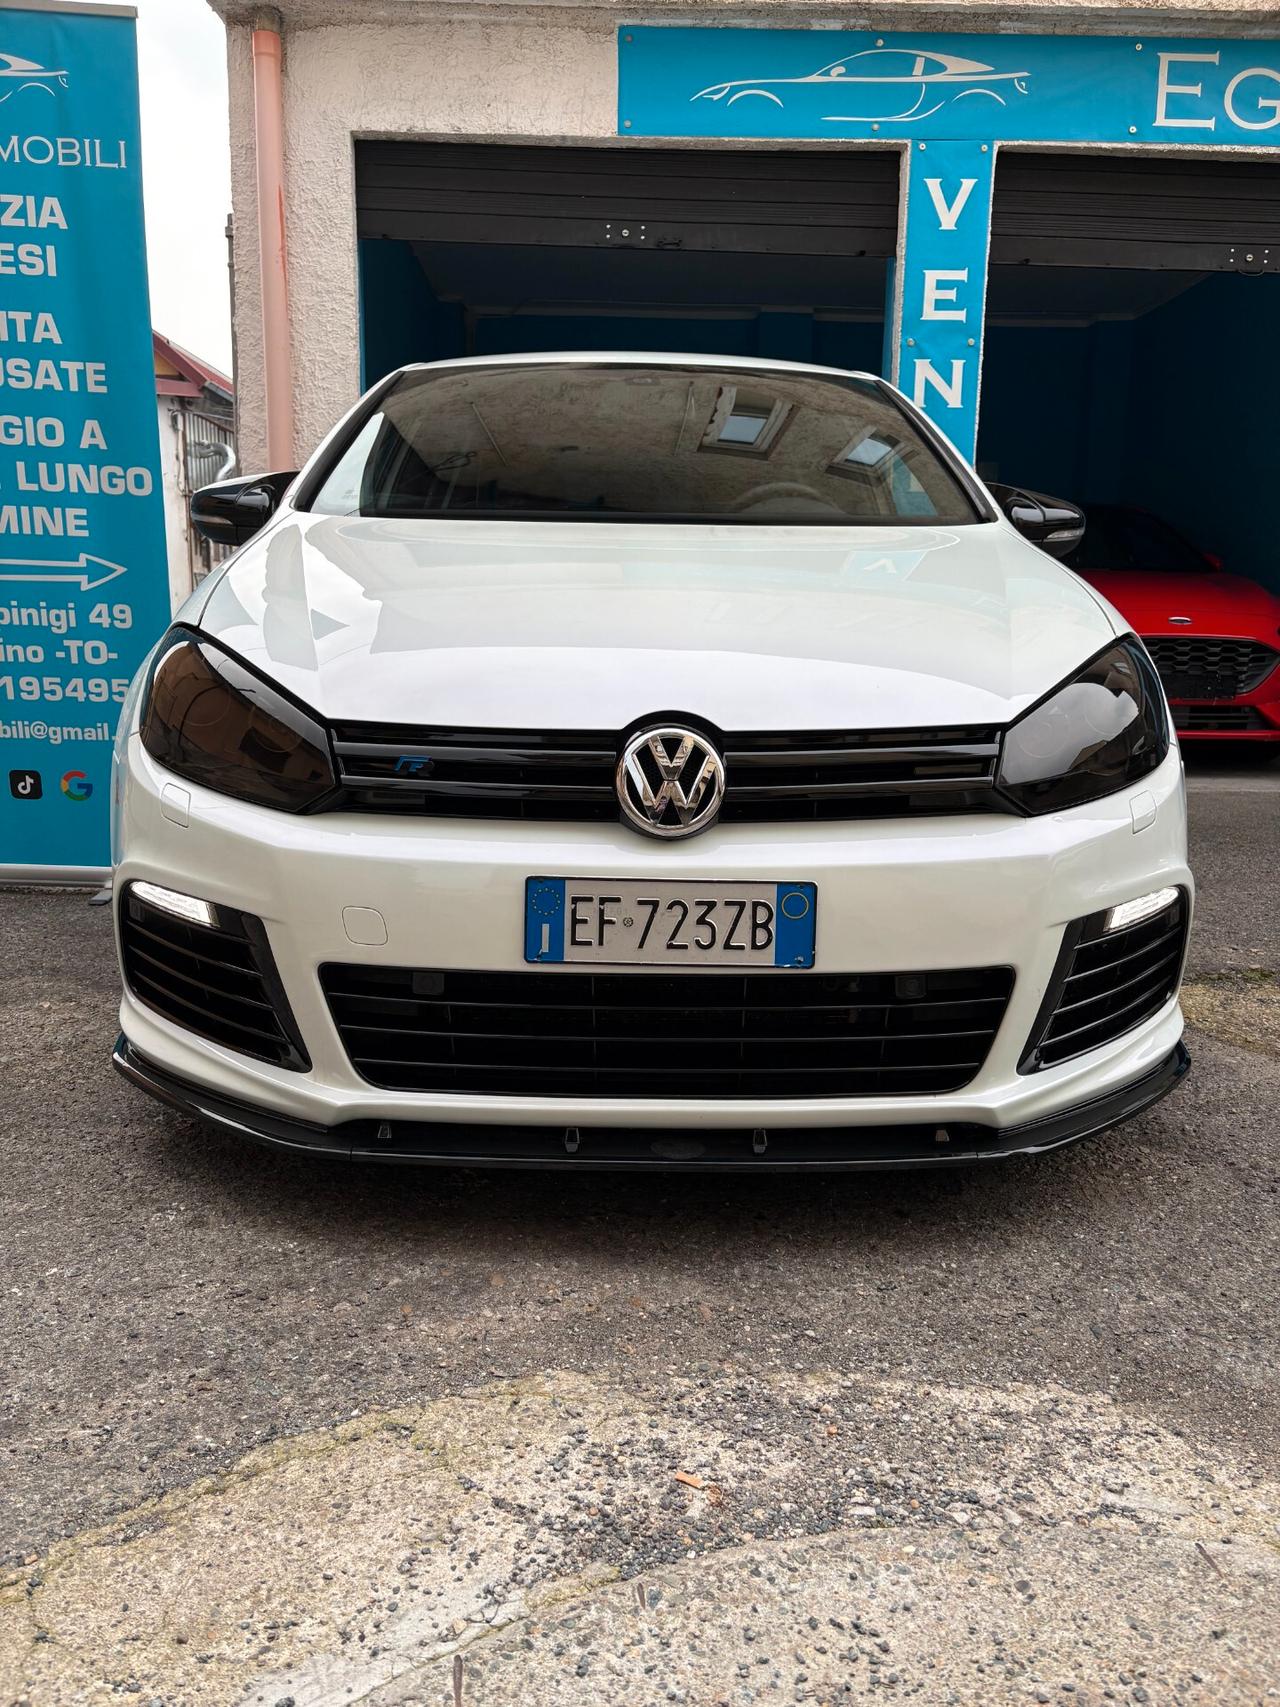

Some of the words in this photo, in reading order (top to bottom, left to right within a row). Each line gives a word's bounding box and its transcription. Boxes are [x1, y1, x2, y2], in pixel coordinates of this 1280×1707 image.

[1152, 51, 1280, 130] EG
[0, 193, 69, 230] ZIA
[0, 357, 108, 394] SATE
[0, 415, 65, 448] GIO
[80, 419, 108, 450] A
[16, 460, 153, 497] LUNGO
[89, 603, 133, 629] 49
[56, 640, 118, 665] -TO-
